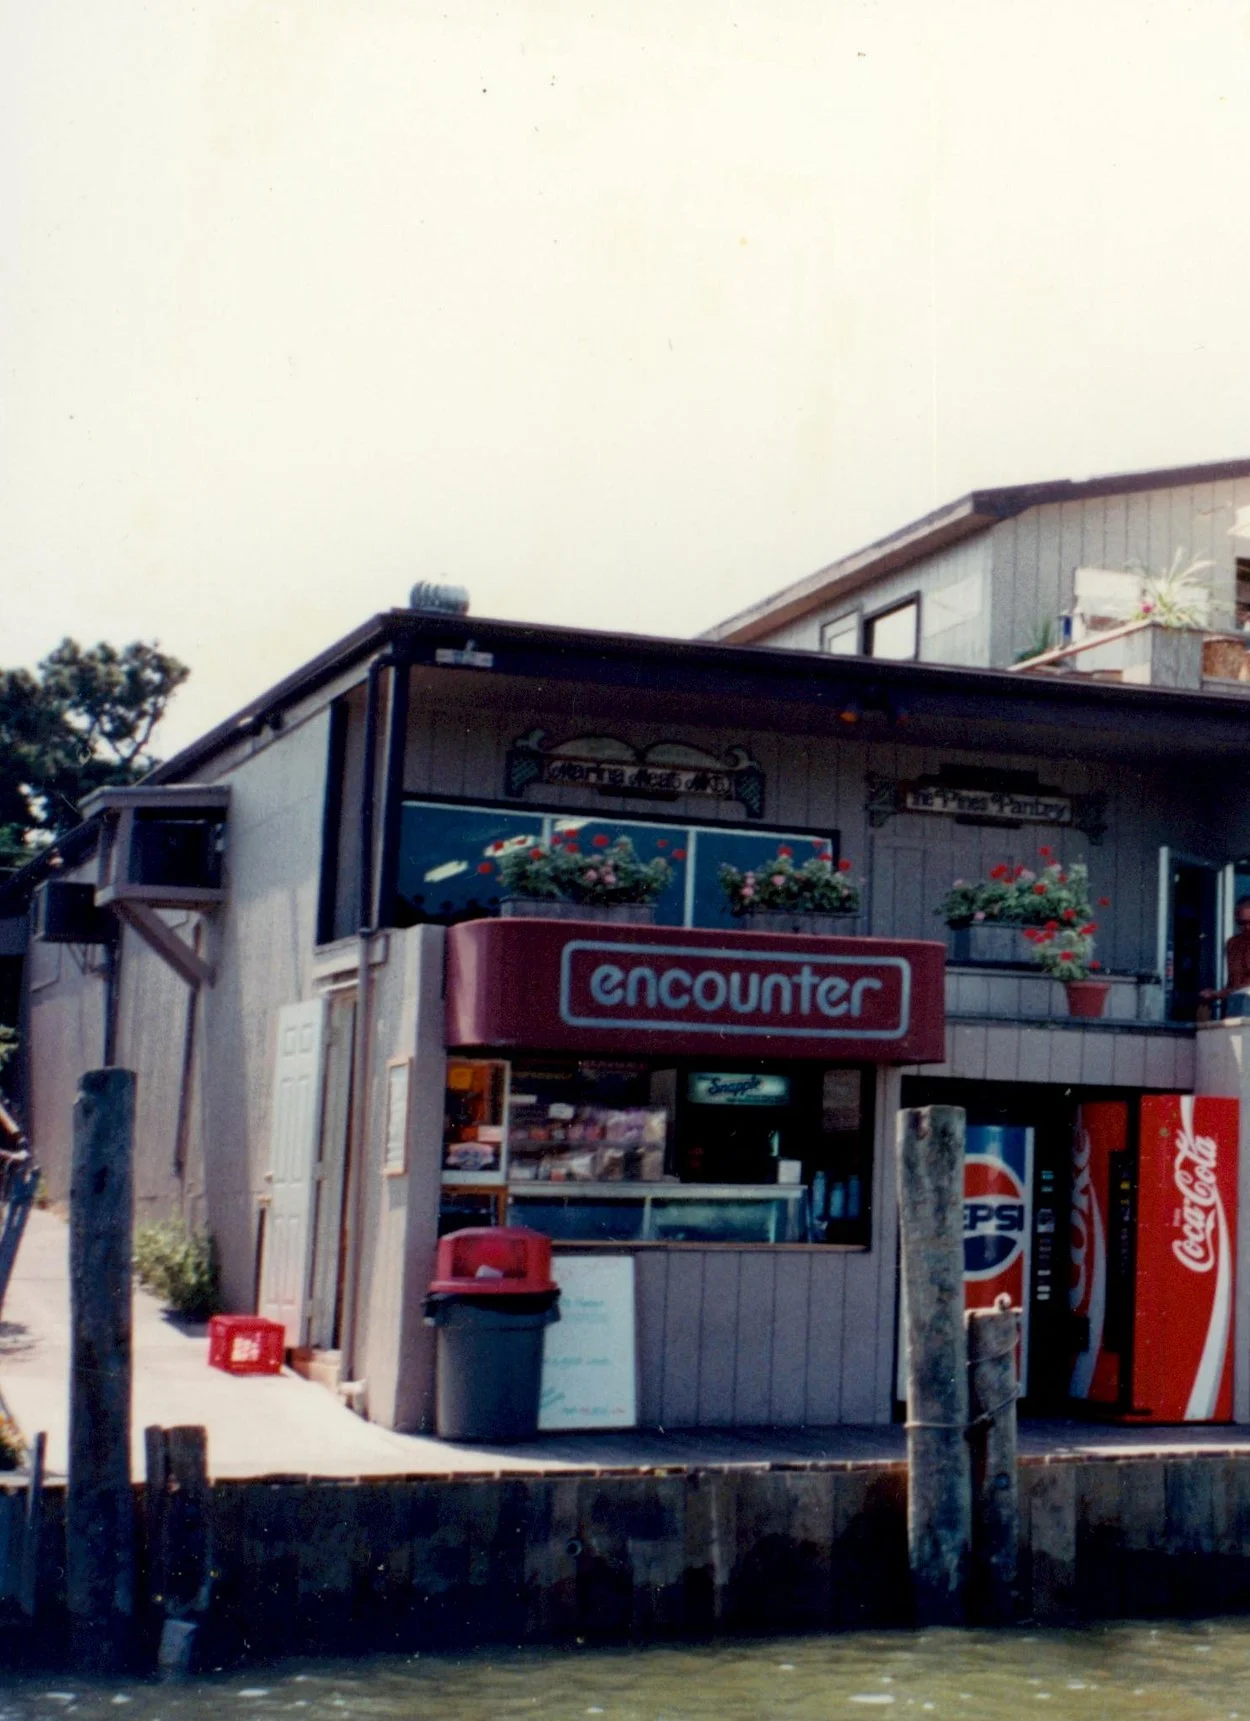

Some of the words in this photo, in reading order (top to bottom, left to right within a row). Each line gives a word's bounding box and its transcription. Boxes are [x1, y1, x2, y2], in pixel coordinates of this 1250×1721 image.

[990, 792, 1069, 823] Pantry
[590, 964, 883, 1018] encounter
[707, 1074, 762, 1097] Snapple
[1172, 1129, 1217, 1273] Coca-Cola
[963, 1203, 1025, 1232] PSI
